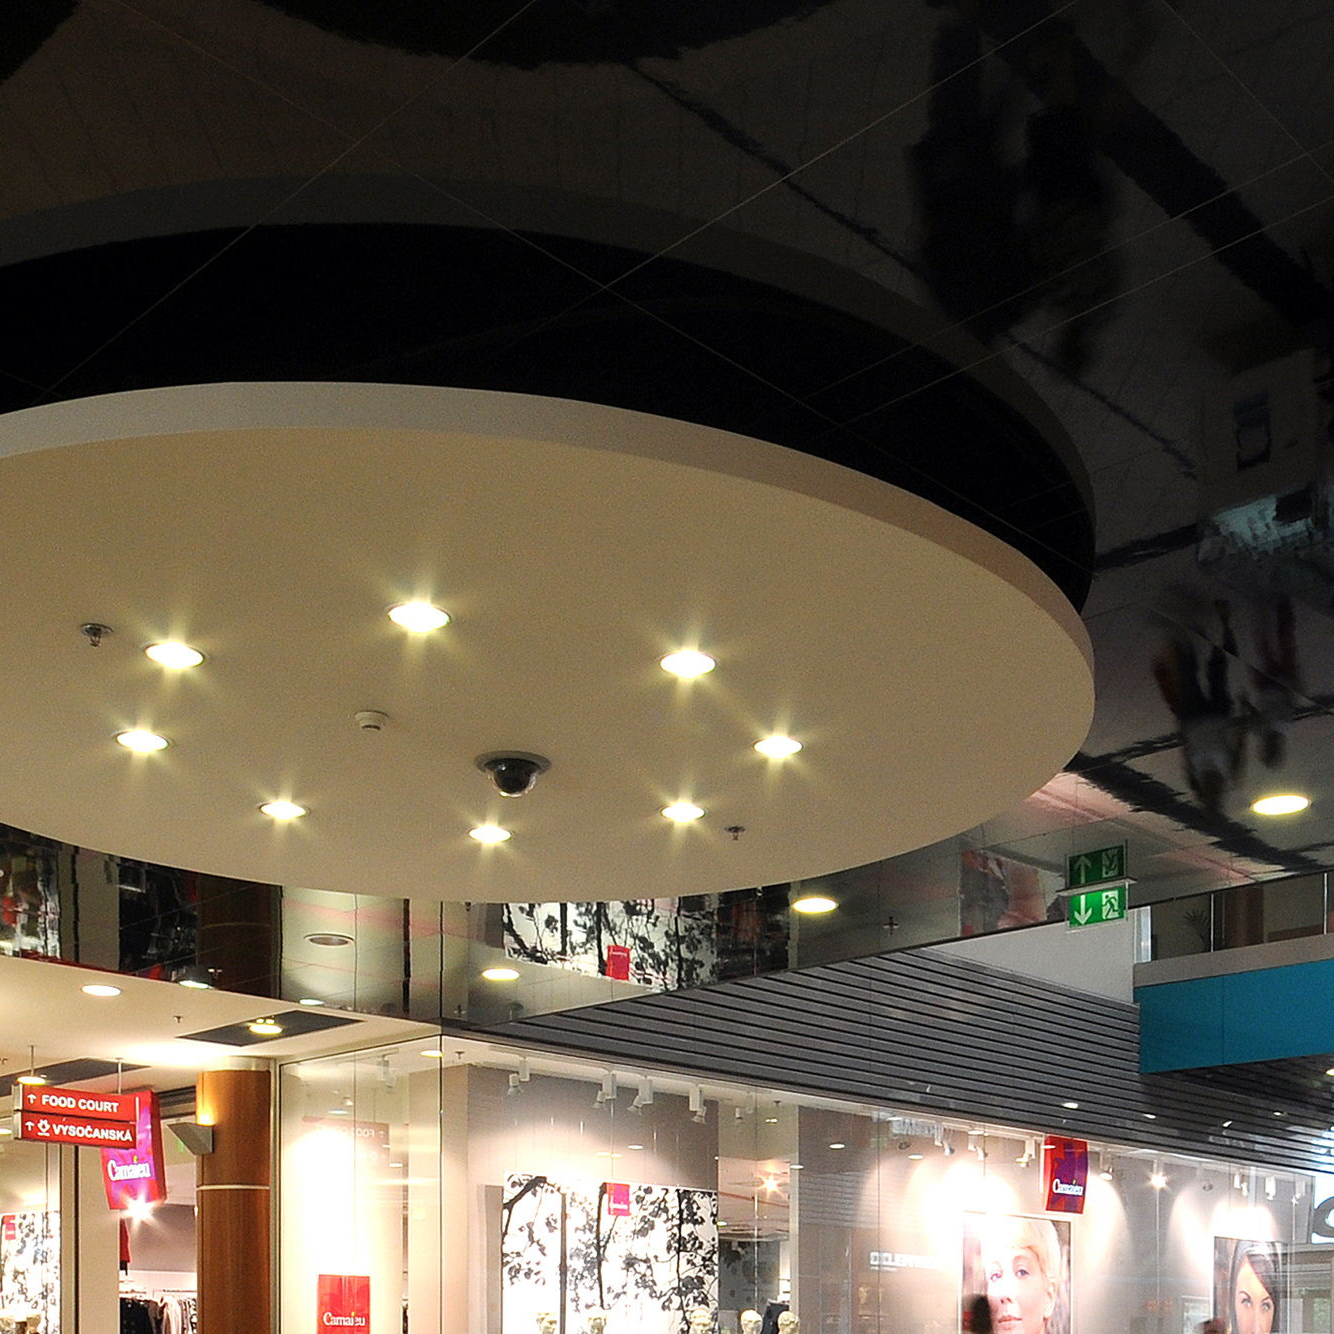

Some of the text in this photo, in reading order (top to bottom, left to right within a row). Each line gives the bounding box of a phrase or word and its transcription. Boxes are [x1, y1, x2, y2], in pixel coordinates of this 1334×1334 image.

[42, 1095, 119, 1113] FOOD COURT
[52, 1123, 133, 1142] VYSOČANSKÁ
